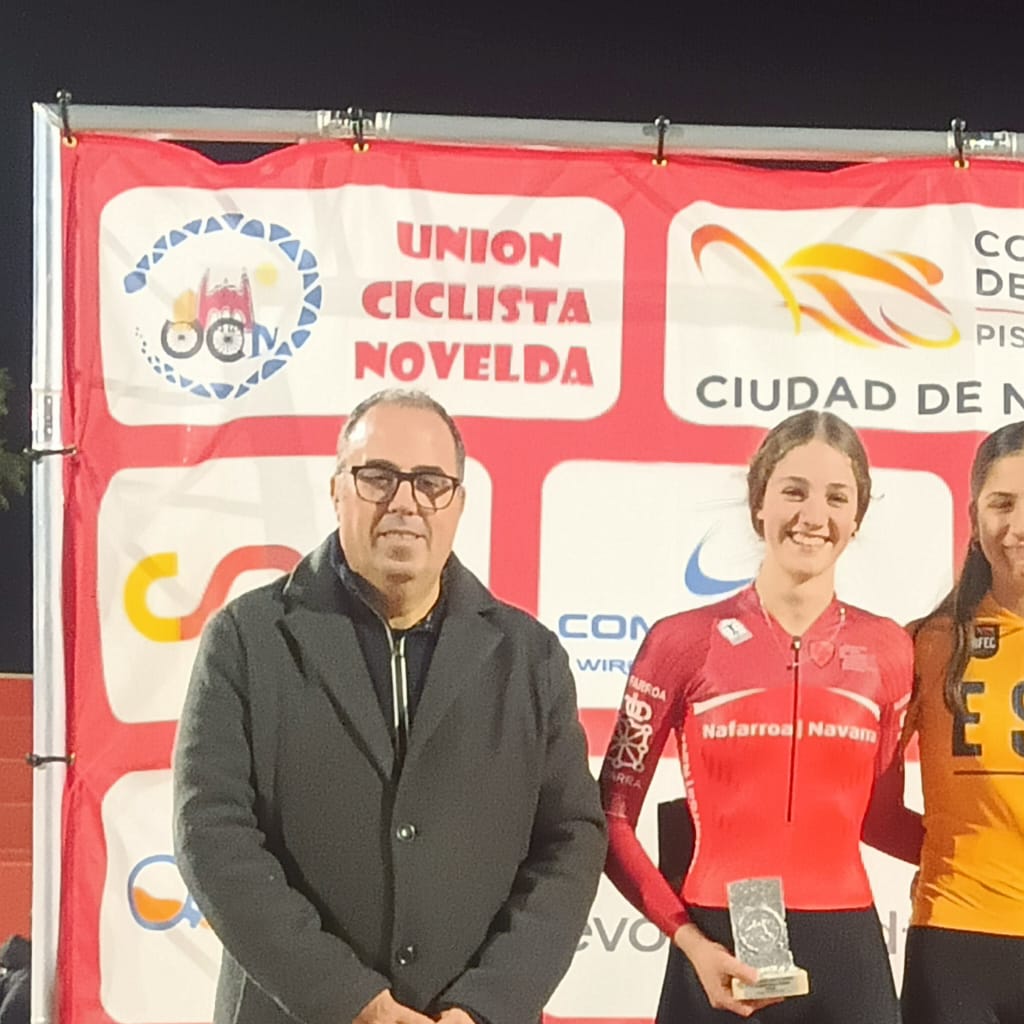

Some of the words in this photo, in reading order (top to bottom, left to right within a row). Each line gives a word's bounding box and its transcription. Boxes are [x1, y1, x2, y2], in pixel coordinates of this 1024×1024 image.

[397, 221, 562, 267] UNION
[361, 280, 591, 324] CICLISTA
[354, 341, 594, 386] NOVELDA
[696, 375, 897, 412] CIUDAD
[918, 381, 982, 415] DE
